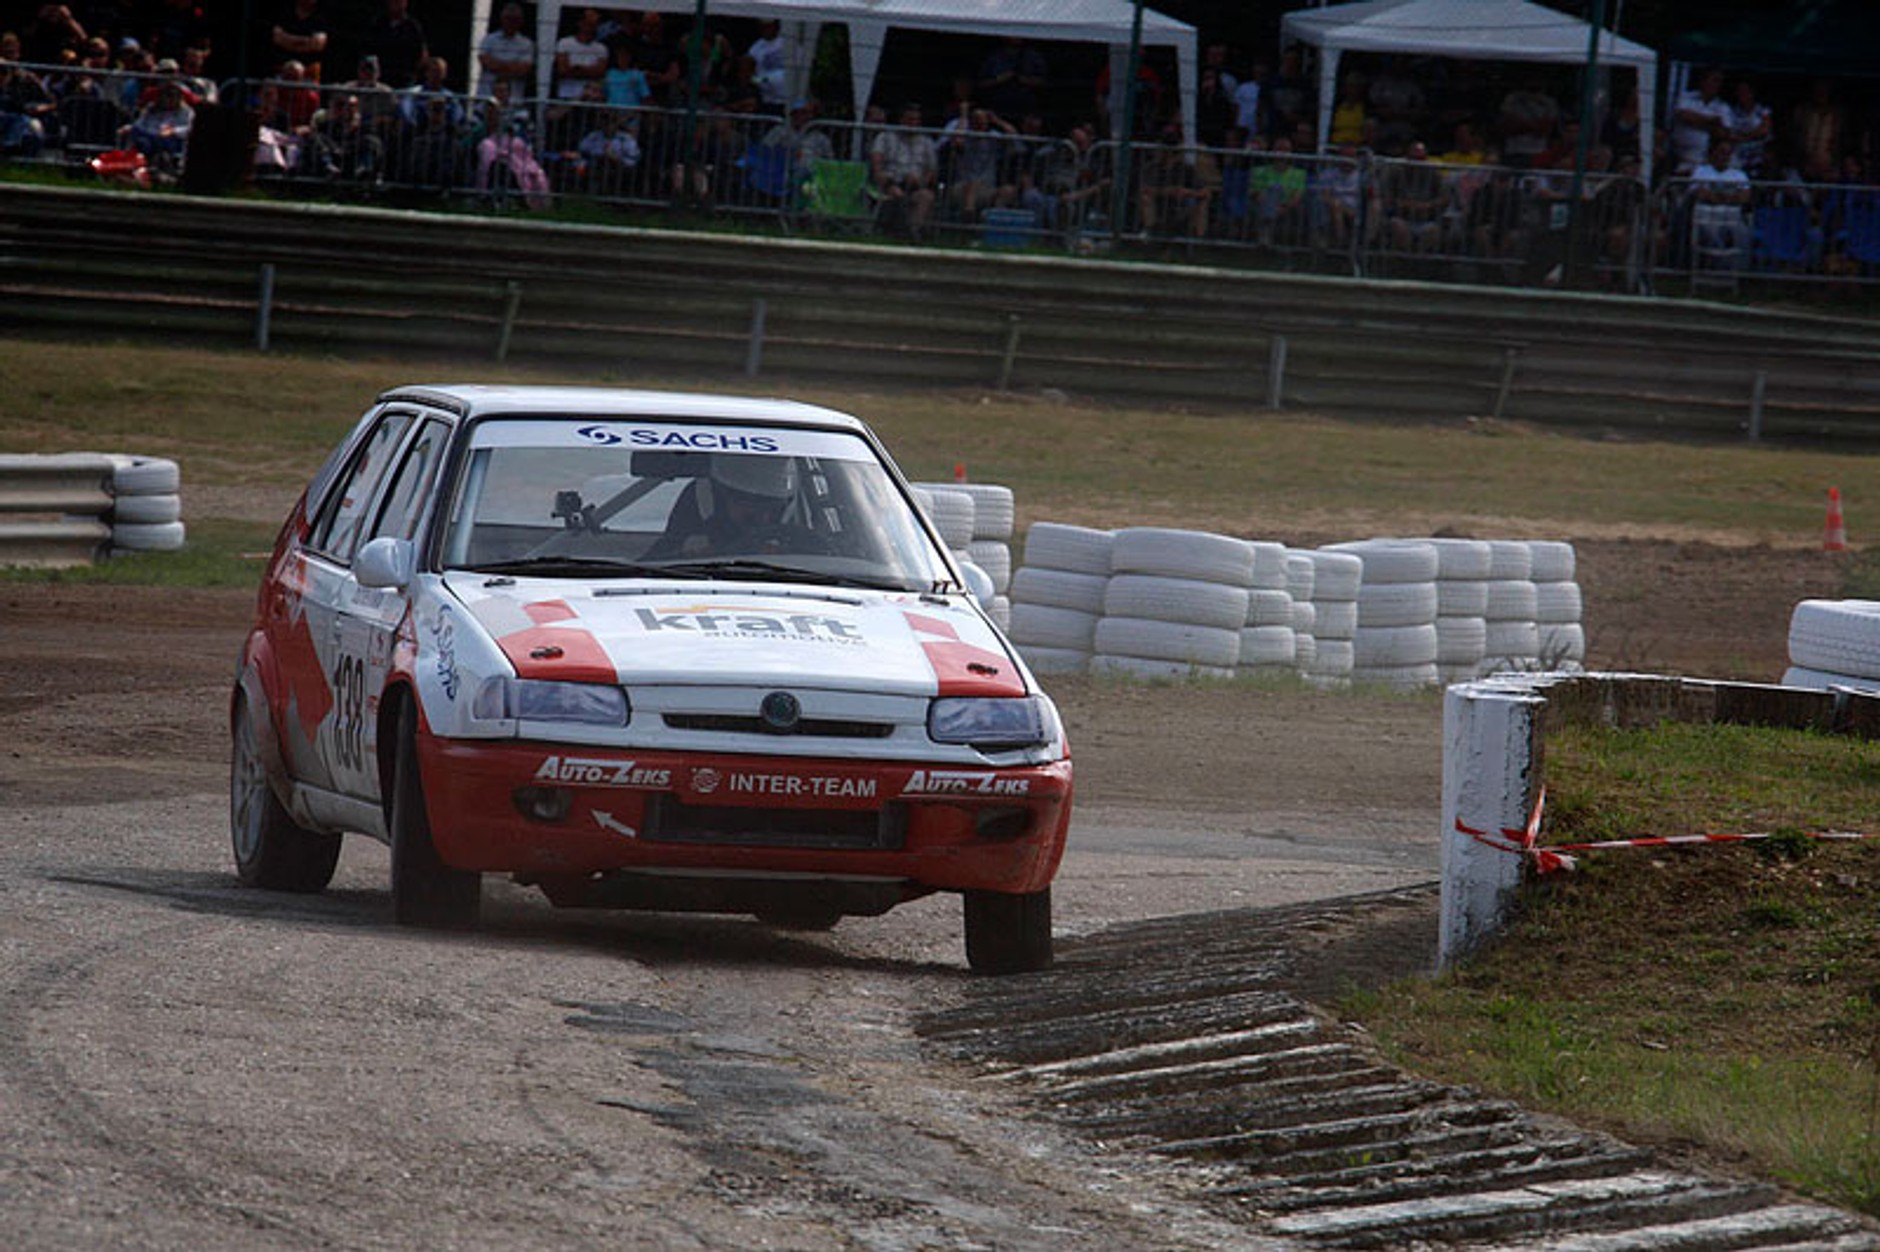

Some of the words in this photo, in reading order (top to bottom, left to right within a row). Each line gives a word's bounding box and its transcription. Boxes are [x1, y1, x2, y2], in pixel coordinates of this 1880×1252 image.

[630, 430, 779, 452] SACHS
[634, 608, 864, 640] kraft
[534, 756, 671, 786] AUTO-ZEKS
[730, 773, 877, 798] INTER-TEAM
